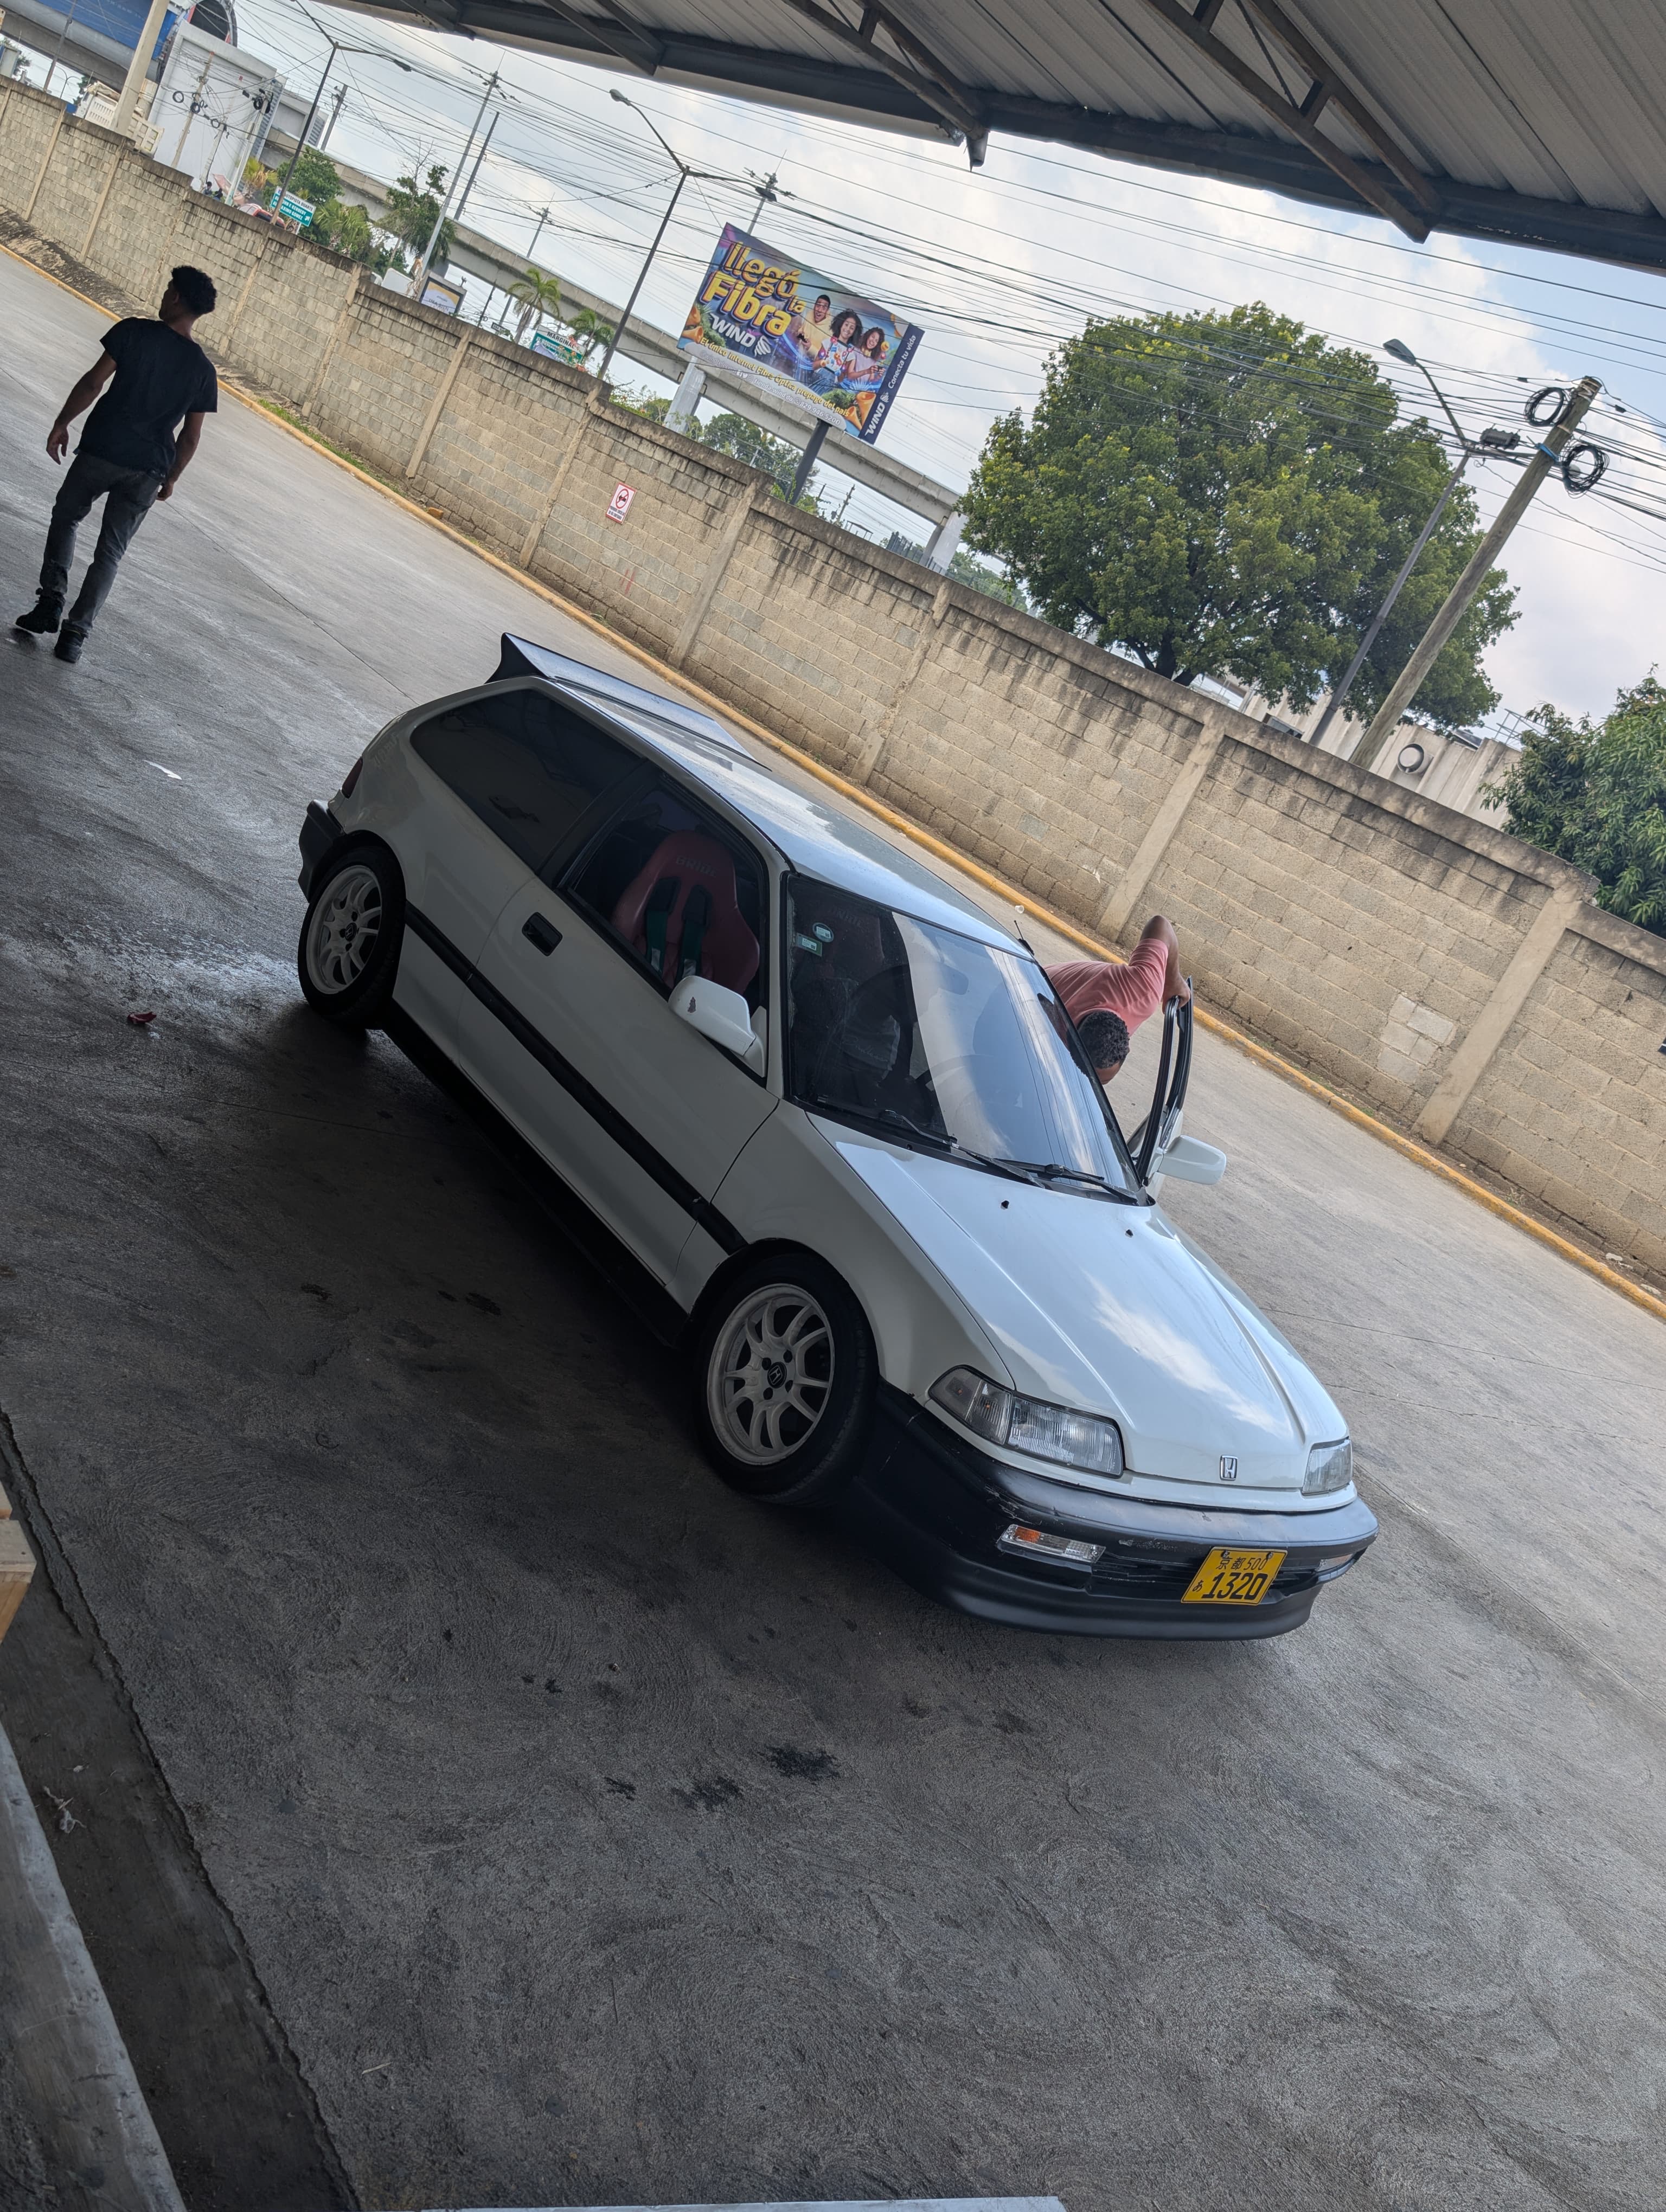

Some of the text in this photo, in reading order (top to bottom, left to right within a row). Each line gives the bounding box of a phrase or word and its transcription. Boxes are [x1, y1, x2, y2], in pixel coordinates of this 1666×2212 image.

[281, 205, 292, 214] AXIMO
[285, 194, 300, 205] UTOPISTA
[701, 271, 792, 337] Fibra
[787, 296, 807, 314] la
[547, 331, 575, 348] MARGINAL
[710, 313, 756, 348] WIND
[700, 337, 708, 347] El
[796, 387, 823, 404] prepago
[823, 399, 836, 410] del
[864, 335, 917, 436] WIND Conecta tu vida
[799, 401, 841, 426] 829.946.5200
[1244, 1558, 1268, 1571] 500
[1192, 1572, 1268, 1600] あ 1320
